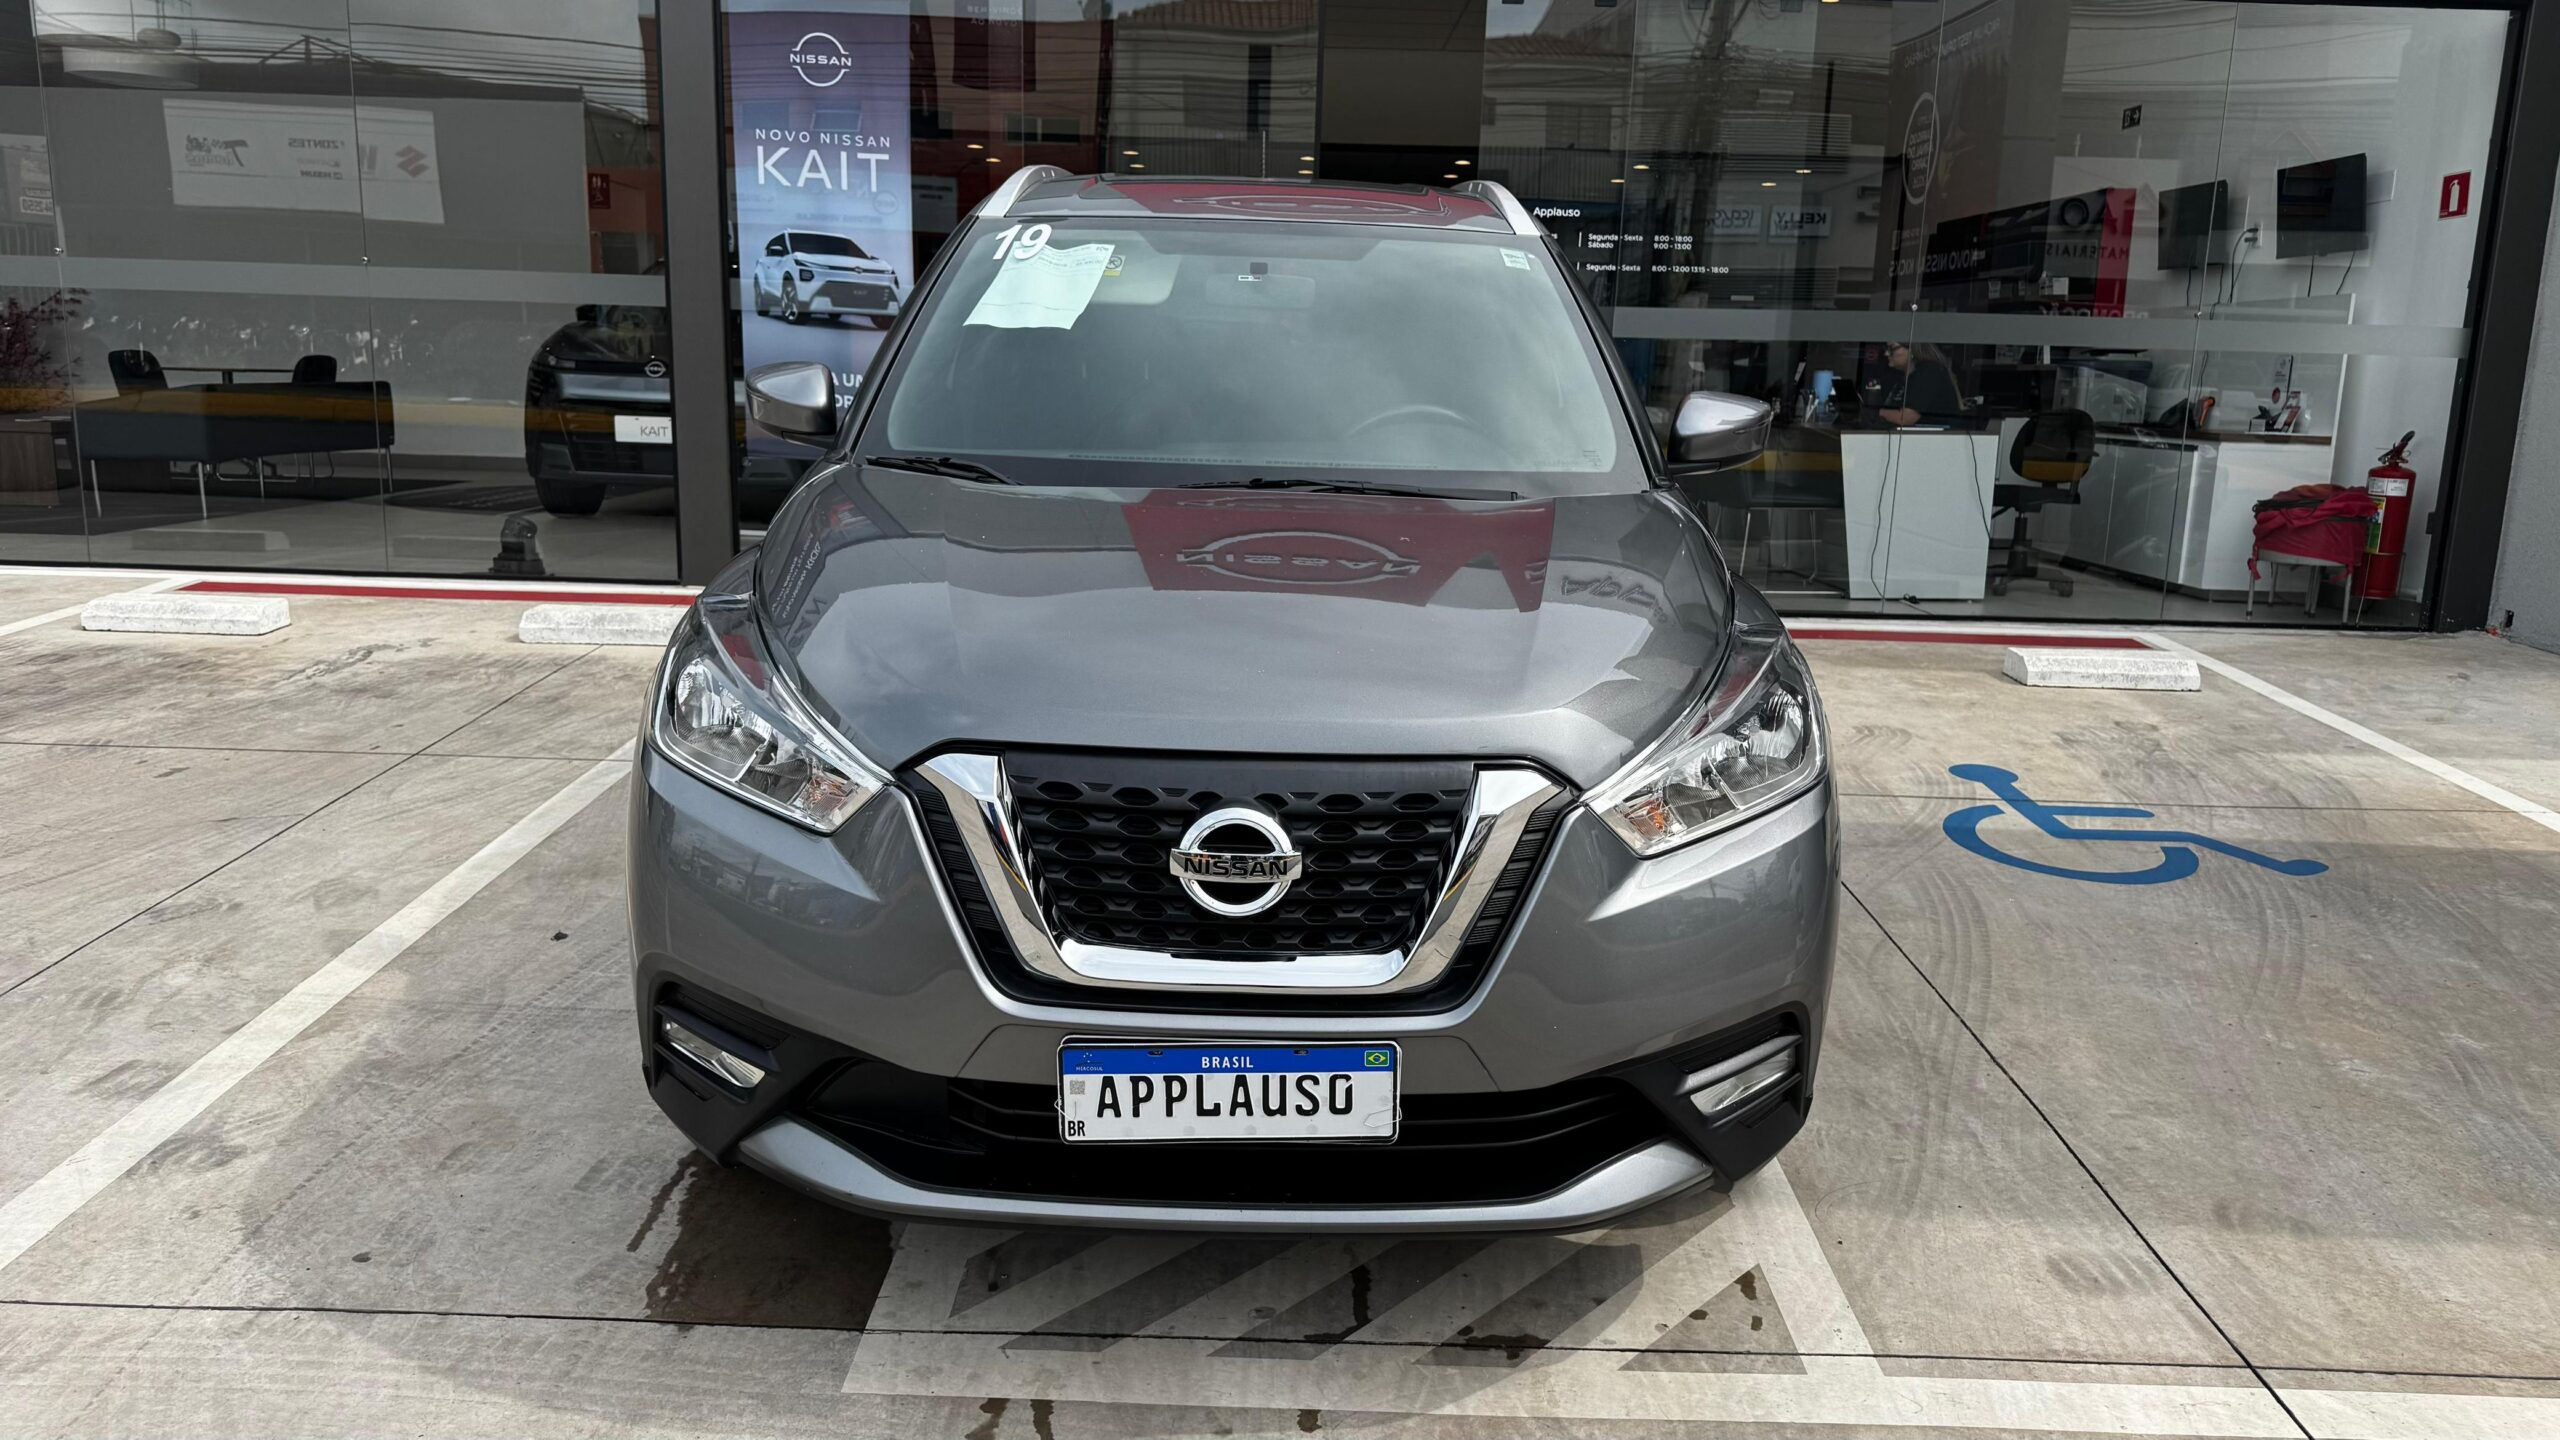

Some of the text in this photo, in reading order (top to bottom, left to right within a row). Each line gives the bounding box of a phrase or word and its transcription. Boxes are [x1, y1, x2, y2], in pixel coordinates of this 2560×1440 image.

[789, 53, 852, 67] NISSAN
[755, 128, 890, 148] NOVO NISSAN
[756, 145, 890, 193] KAIT
[1533, 207, 1581, 218] Applauso
[993, 224, 1053, 260] 19
[1588, 233, 1618, 242] Segunda
[1623, 233, 1644, 242] Sexta
[1675, 235, 1693, 243] 18:00
[1586, 263, 1616, 272] Segunda
[1621, 264, 1641, 272] Sexta
[640, 425, 669, 438] KAIT
[1183, 857, 1288, 877] NISSAN
[1201, 1055, 1254, 1069] BRASIL
[1096, 1073, 1354, 1119] APPLAUSO
[1067, 1120, 1086, 1138] BR
